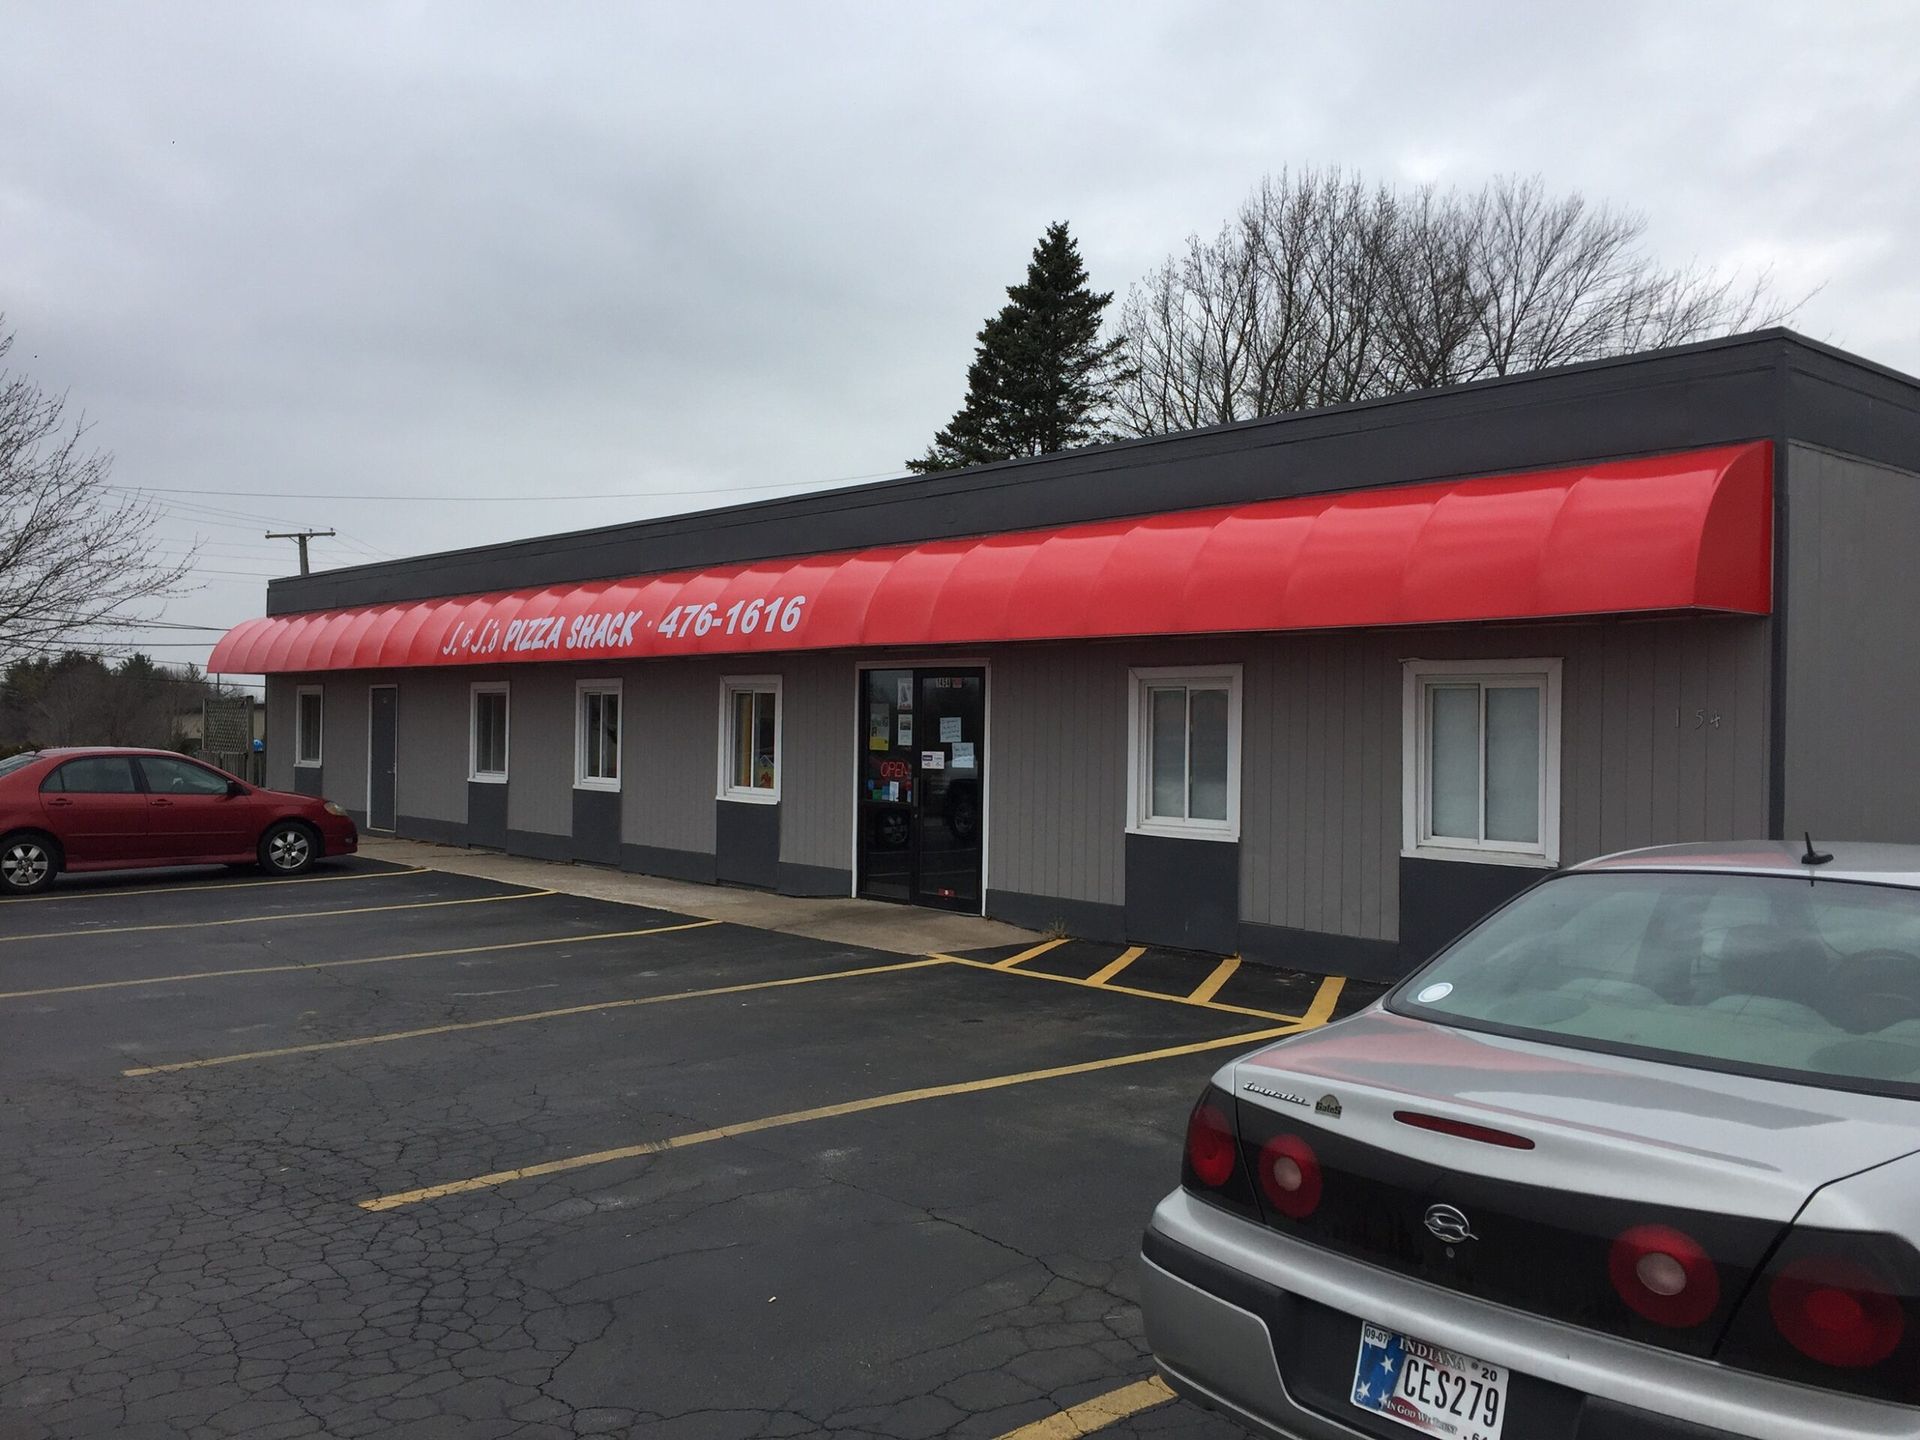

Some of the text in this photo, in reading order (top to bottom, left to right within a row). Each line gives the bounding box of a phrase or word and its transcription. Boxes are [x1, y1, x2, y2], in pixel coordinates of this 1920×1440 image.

[502, 616, 566, 652] PIZZA
[566, 610, 643, 650] SHACK
[657, 595, 806, 639] 476-1616
[880, 760, 909, 778] OPEN
[1365, 1327, 1388, 1344] 09-07
[1398, 1337, 1466, 1372] INDIANA
[1481, 1367, 1498, 1382] 20
[1403, 1358, 1500, 1428] CES279
[1386, 1400, 1397, 1411] IN
[1397, 1404, 1416, 1419] GOD
